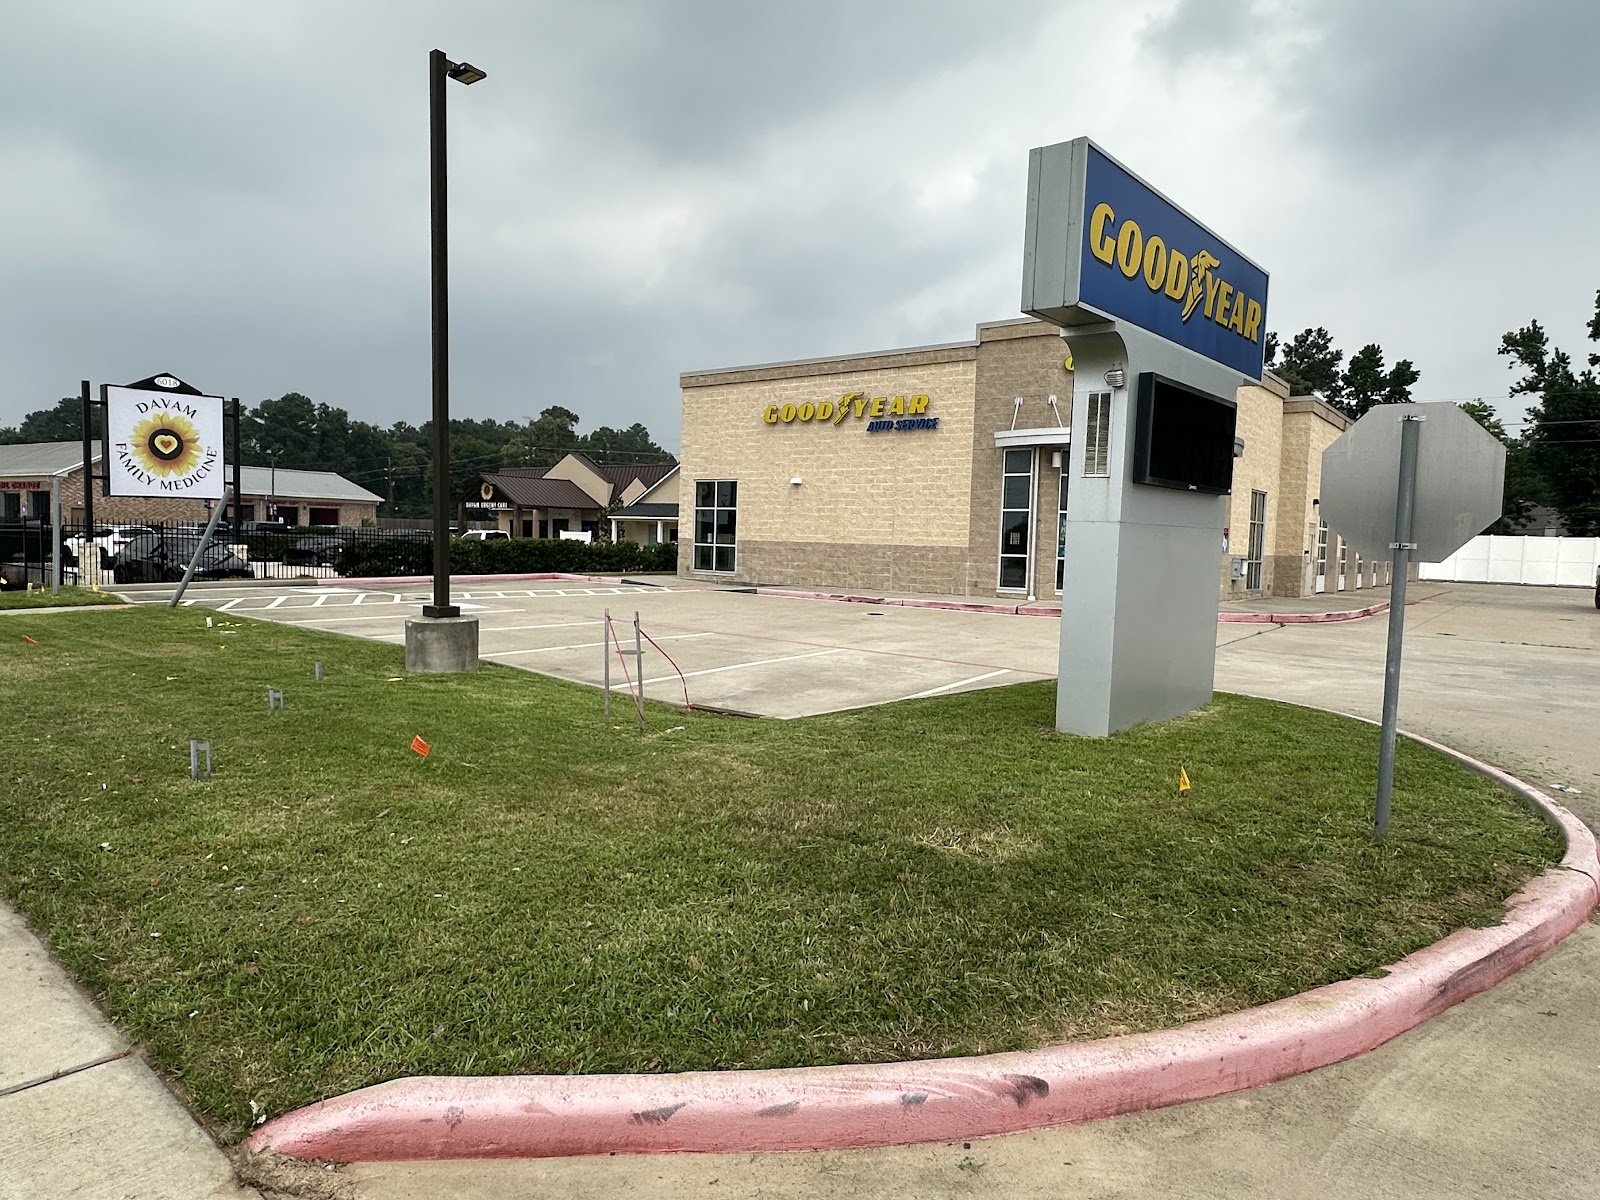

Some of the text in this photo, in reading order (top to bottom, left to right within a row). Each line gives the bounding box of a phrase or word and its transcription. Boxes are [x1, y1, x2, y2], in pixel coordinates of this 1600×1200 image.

[1090, 203, 1262, 343] GOODYEAR
[156, 377, 179, 388] 6018
[135, 397, 197, 419] DAVAM
[764, 393, 930, 425] GOODYEAR
[866, 417, 940, 432] AUTO SERVICE
[115, 442, 218, 492] FAMILY MEDICINE
